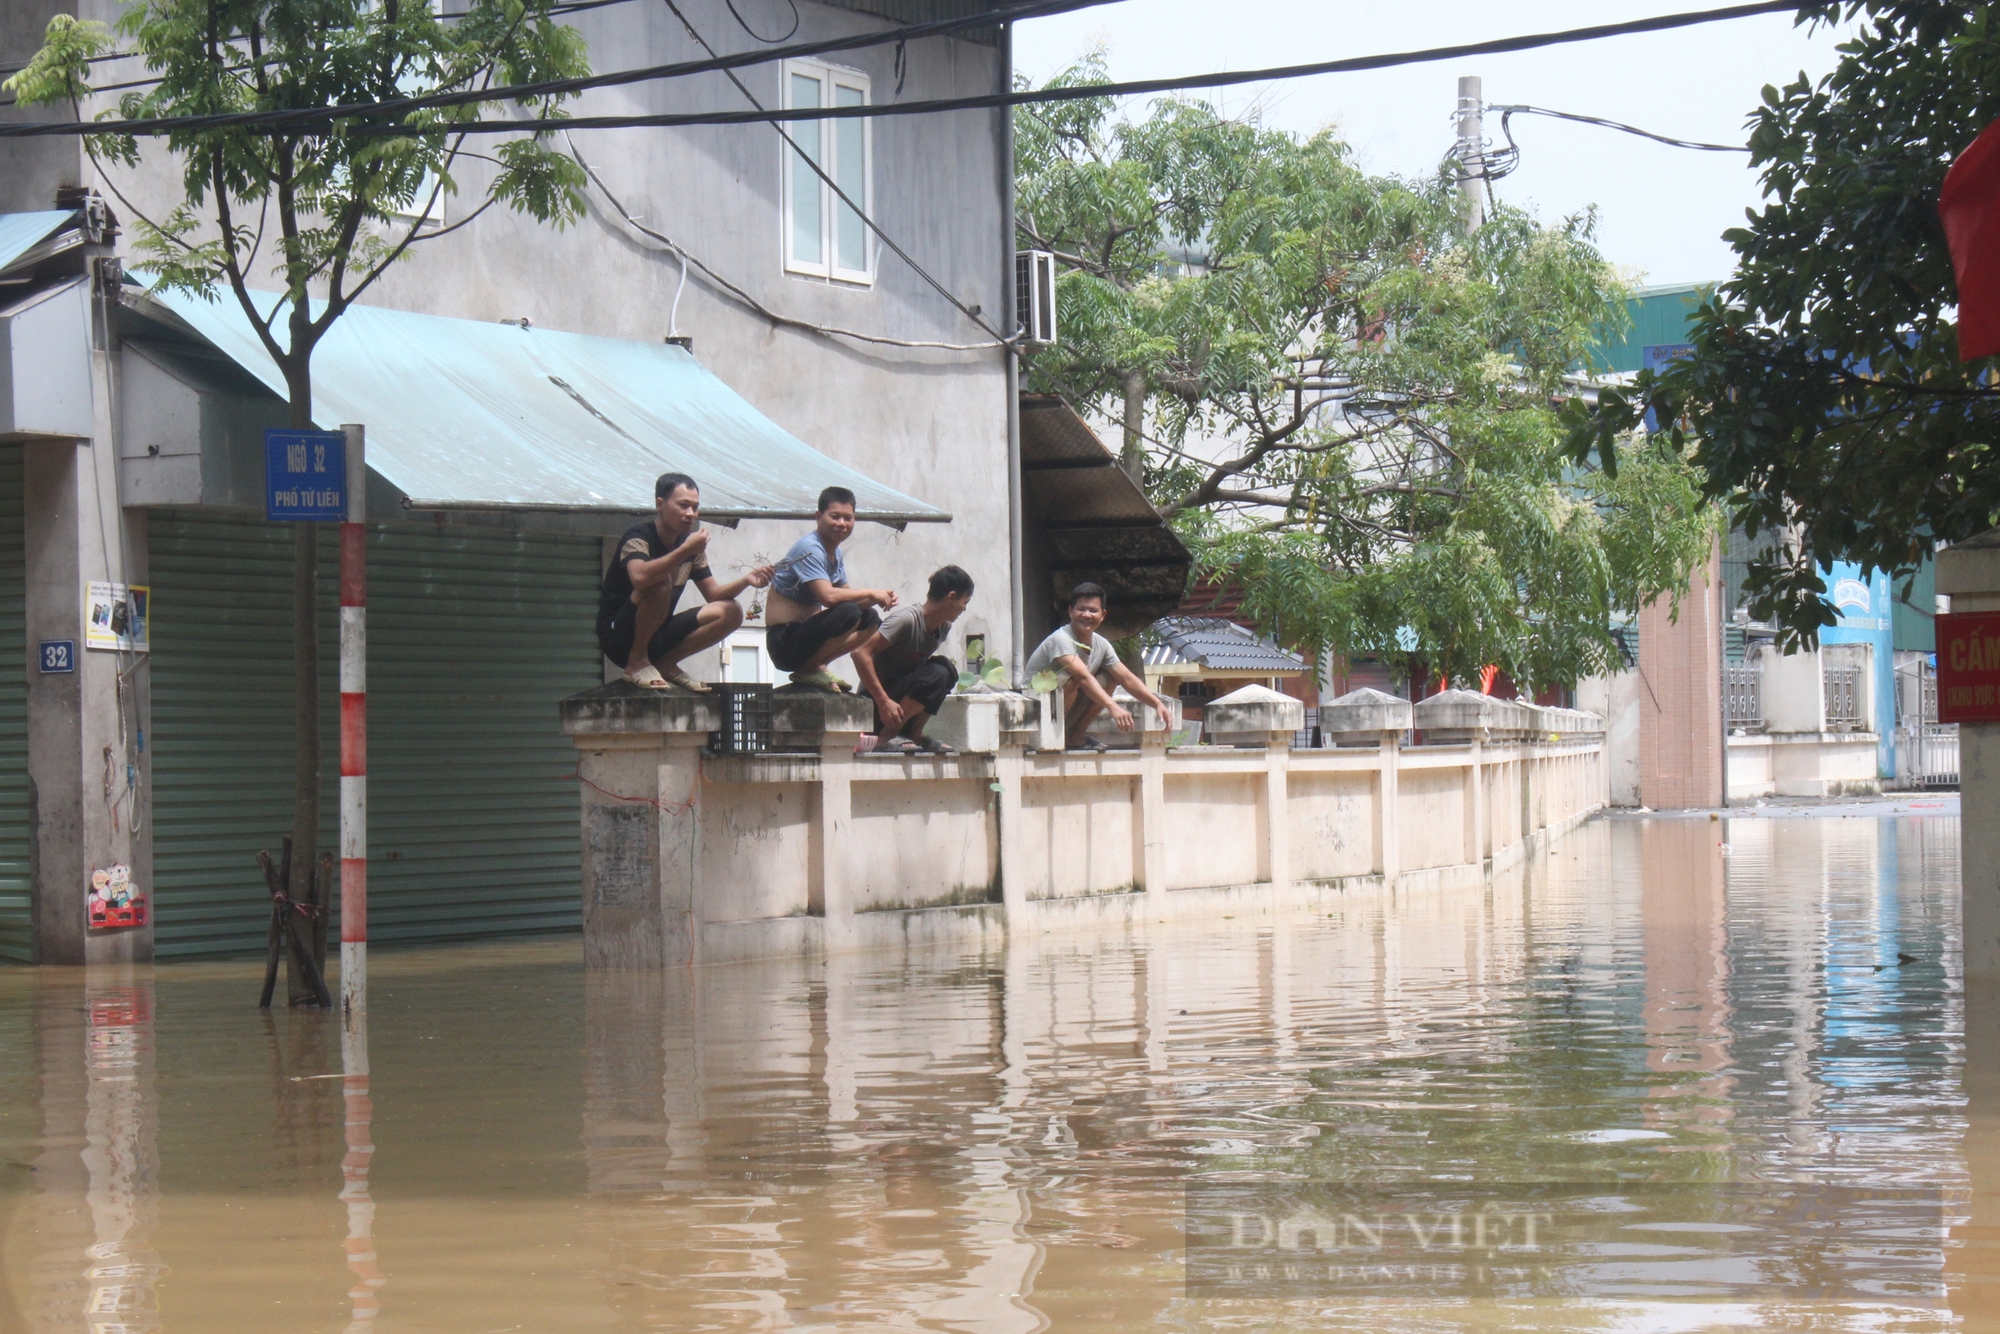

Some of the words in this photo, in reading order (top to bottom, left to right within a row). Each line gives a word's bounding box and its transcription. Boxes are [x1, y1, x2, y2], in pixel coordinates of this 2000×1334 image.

[287, 439, 307, 473] NGÕ
[314, 445, 326, 473] 32
[275, 486, 298, 507] PHỐ
[301, 487, 315, 507] TỨ
[317, 487, 340, 507] LIÊN
[45, 645, 67, 667] 32
